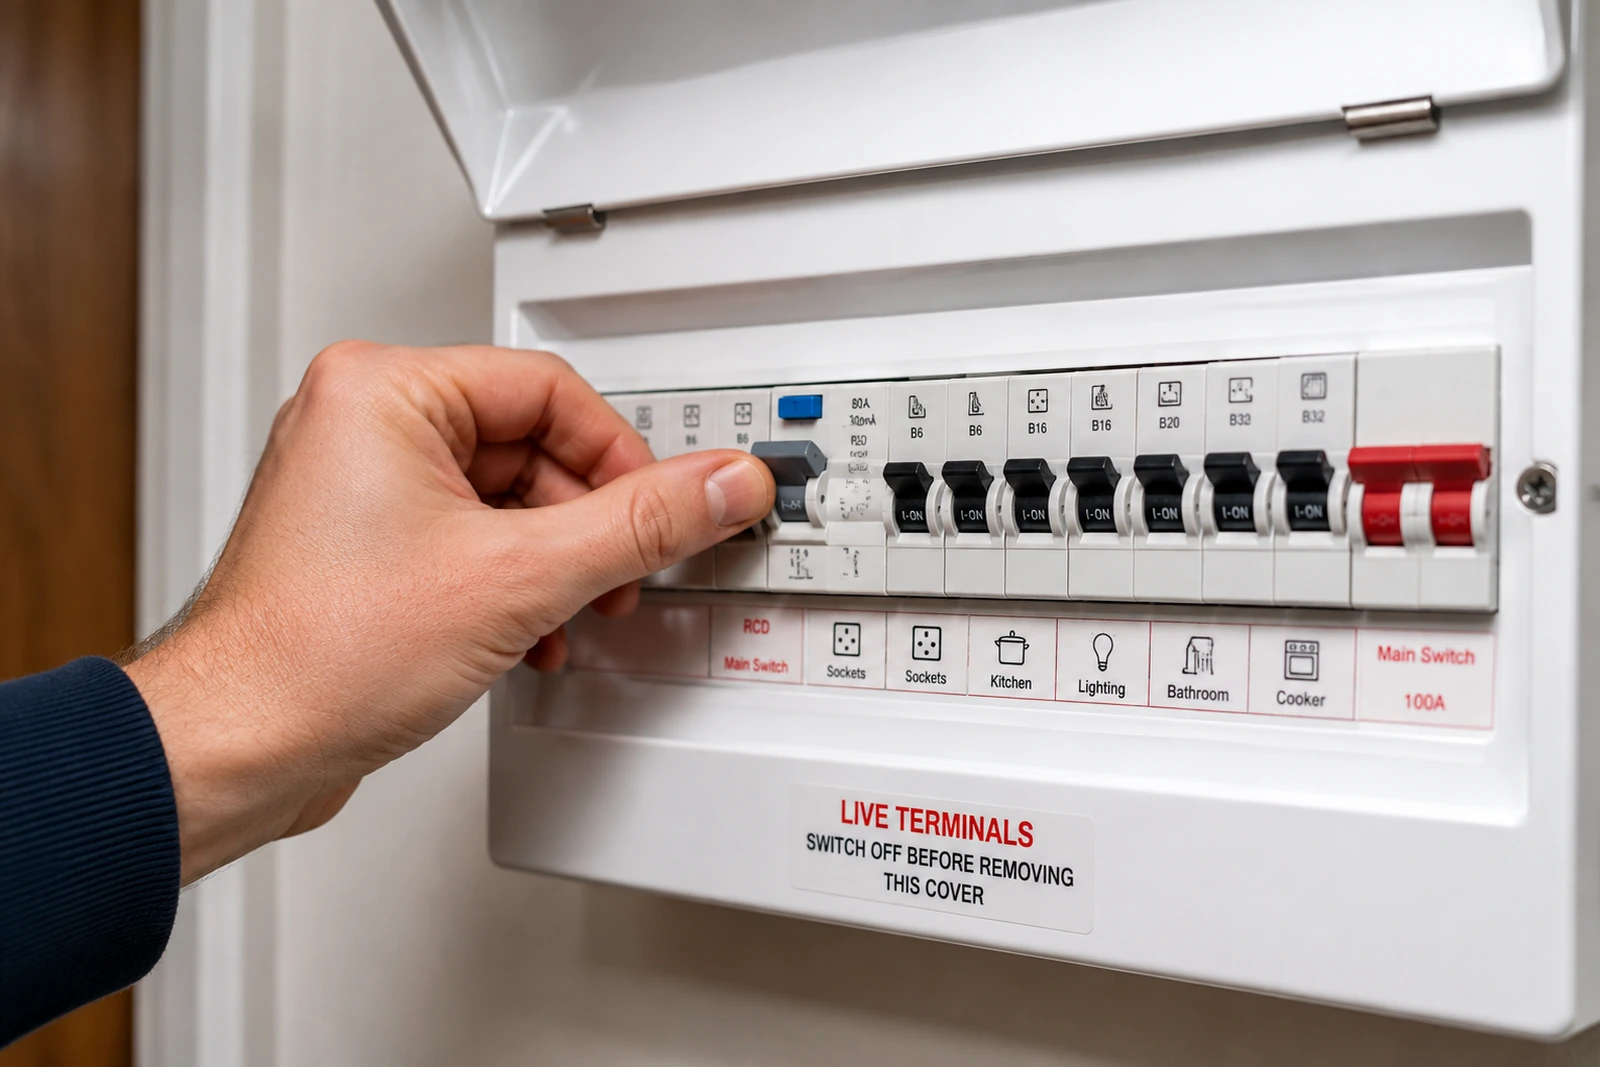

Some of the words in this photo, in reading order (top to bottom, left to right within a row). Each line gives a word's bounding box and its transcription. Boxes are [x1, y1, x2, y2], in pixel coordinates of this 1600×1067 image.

[1159, 417, 1180, 429] B20
[1302, 410, 1325, 423] B32
[910, 426, 924, 438] B6
[968, 424, 983, 436] B6
[1028, 422, 1048, 434] B16
[1092, 420, 1112, 432] B16
[743, 619, 770, 636] RCD
[1377, 645, 1416, 665] Main
[1420, 646, 1476, 666] Switch
[724, 656, 750, 672] Main
[752, 658, 788, 674] Switch
[826, 666, 866, 681] Sockets
[905, 670, 947, 686] Sockets
[990, 674, 1032, 692] Kitchen
[1078, 679, 1126, 698] Lighting
[1167, 685, 1229, 704] Bathroom
[1276, 690, 1326, 708] Cooker
[1404, 694, 1446, 712] 100A
[840, 799, 888, 830] LIVE
[895, 806, 1034, 848] TERMINALS
[806, 832, 866, 858] SWITCH
[871, 841, 902, 862] OFF
[907, 846, 974, 874] BEFORE
[980, 856, 1074, 888] REMOVING
[883, 872, 920, 895] THIS
[926, 878, 984, 906] COVER
